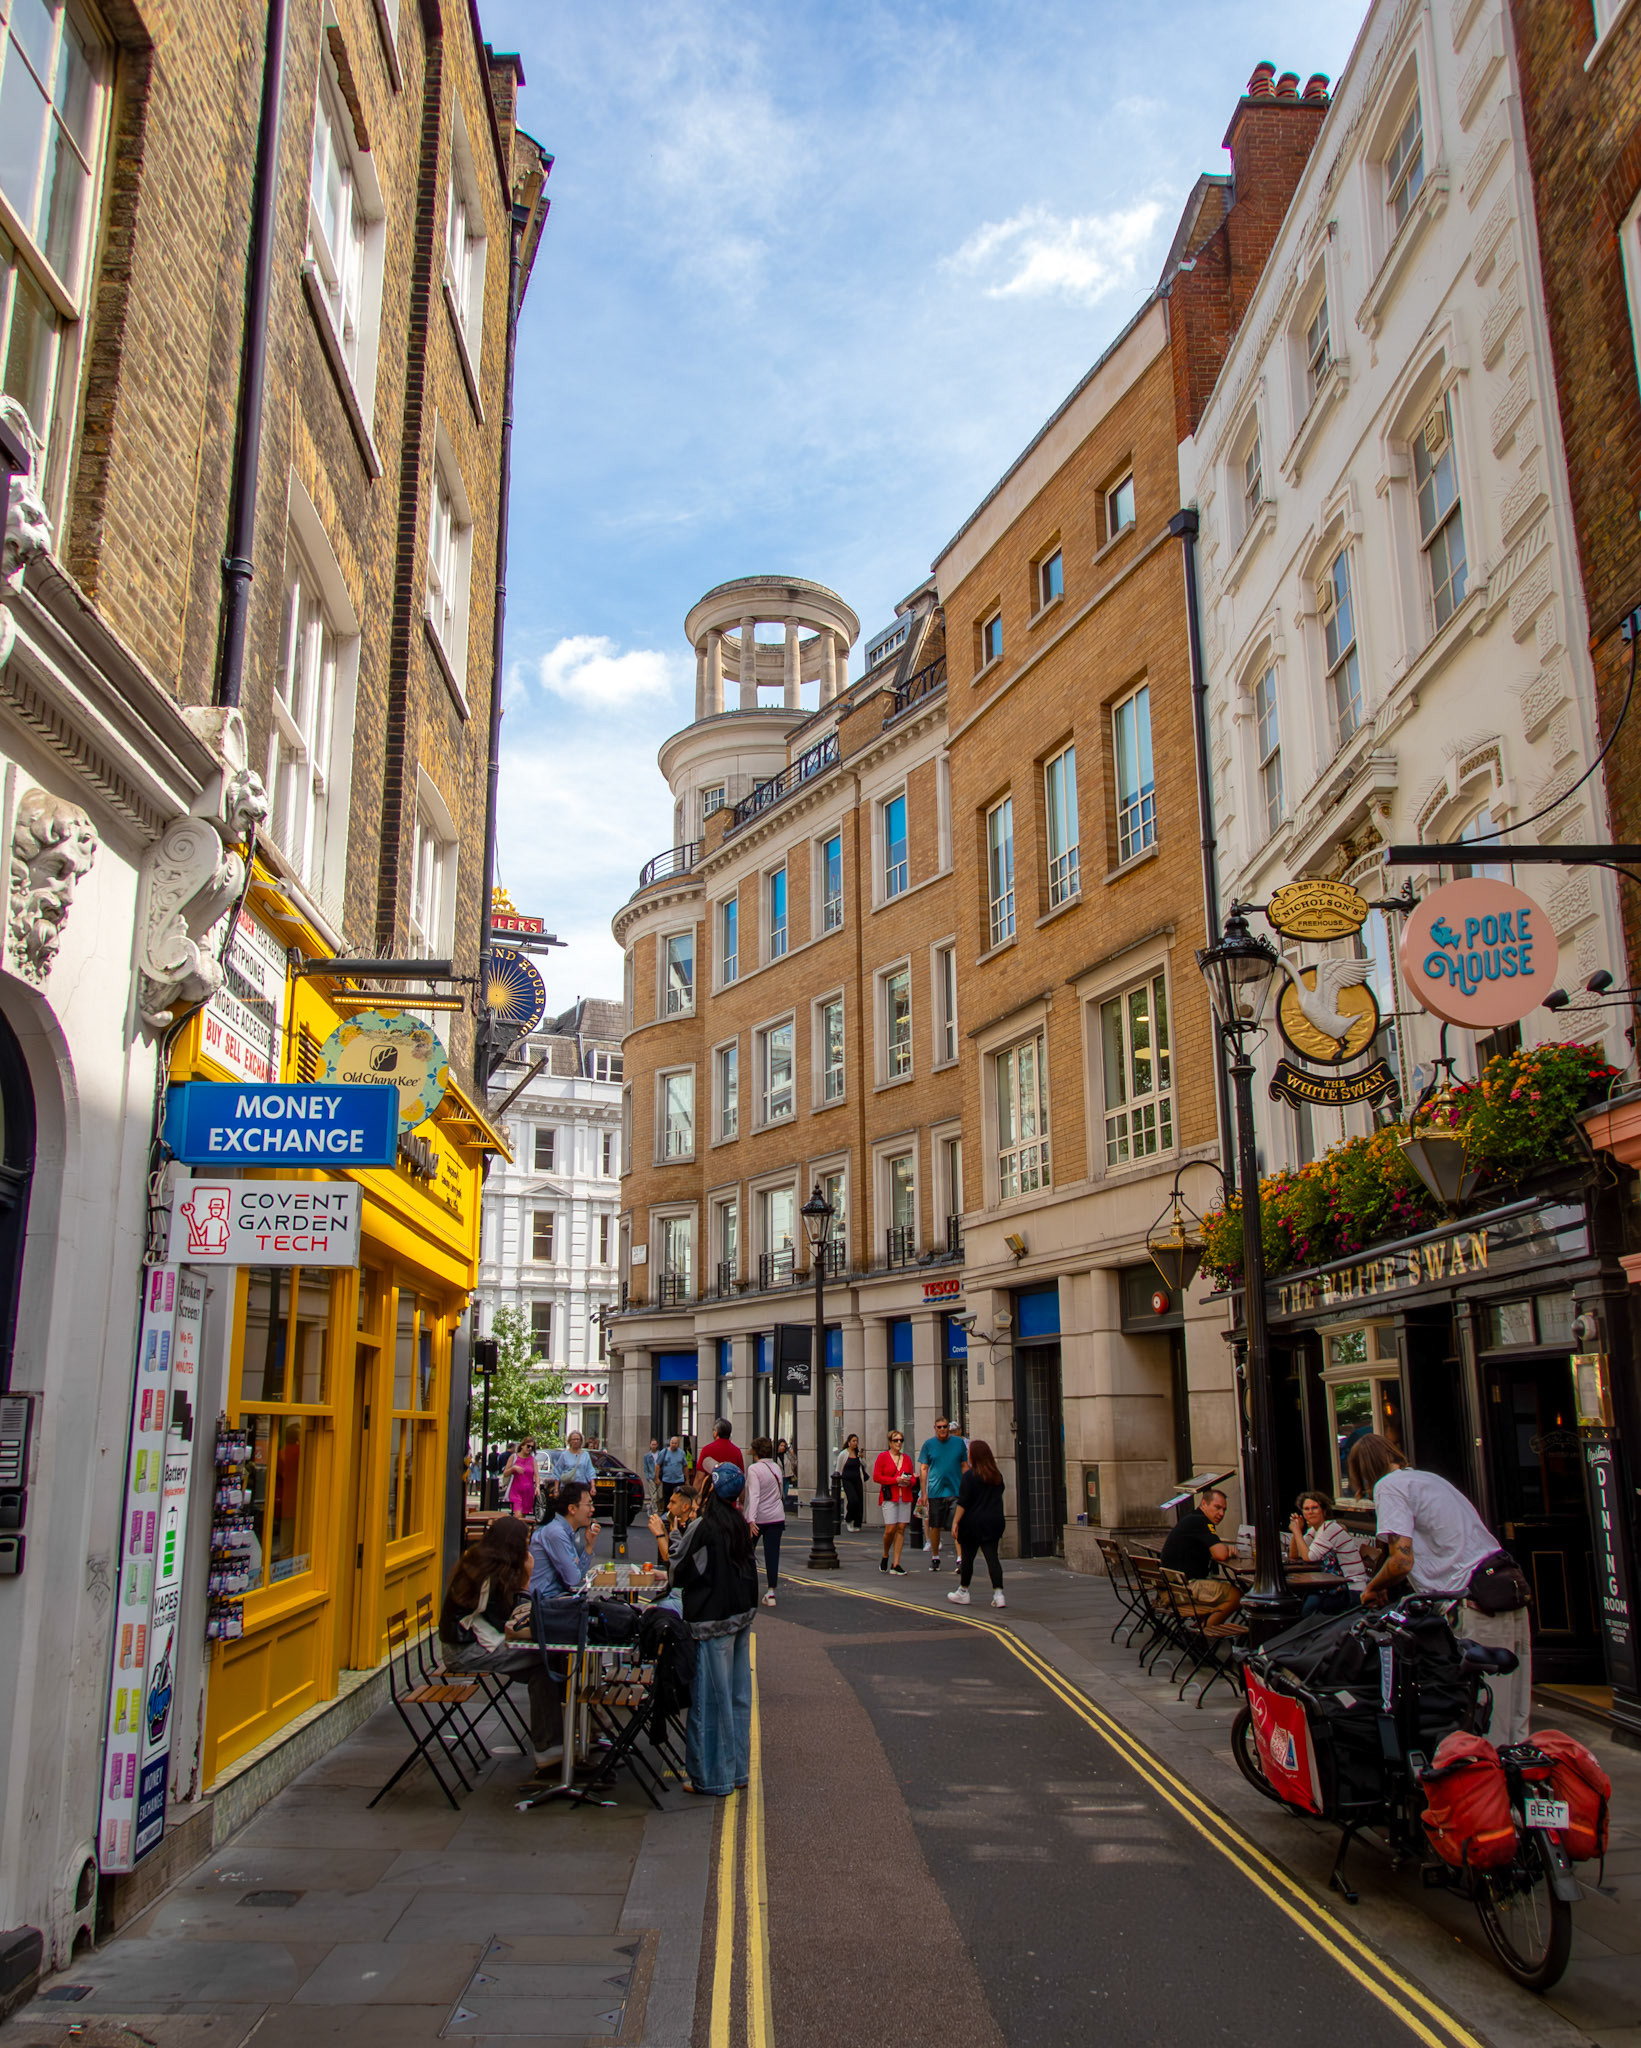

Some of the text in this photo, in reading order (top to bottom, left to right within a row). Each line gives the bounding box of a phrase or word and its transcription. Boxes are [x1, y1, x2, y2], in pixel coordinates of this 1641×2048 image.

[1282, 899, 1359, 919] NICHOLSON'S
[1298, 919, 1343, 927] FREEHOUSE
[1465, 907, 1533, 950] POKE
[1423, 942, 1535, 997] HOUSE
[518, 959, 545, 1005] HOUSE
[214, 991, 240, 1024] MOBILE
[206, 1017, 222, 1049] BUY
[224, 1032, 241, 1064] SELL
[343, 1072, 364, 1083] Old
[398, 1076, 419, 1087] Kee
[1286, 1069, 1386, 1101] WHITE SWAN
[1323, 1079, 1346, 1088] THE
[235, 1095, 343, 1120] MONEY
[208, 1127, 364, 1153] EXCHANGE
[240, 1193, 349, 1211] COVENT
[238, 1214, 348, 1232] GARDEN
[255, 1234, 328, 1252] TECH
[1279, 1228, 1488, 1315] THE WHITE SWAN
[180, 1279, 201, 1300] Broken
[922, 1279, 960, 1297] TESCO
[176, 1362, 194, 1375] MINUTES
[164, 1464, 188, 1485] Battery
[1597, 1467, 1620, 1597] DINING
[154, 1590, 179, 1616] VAPES
[1603, 1596, 1629, 1615] ROOM
[1530, 1804, 1564, 1819] BERT
